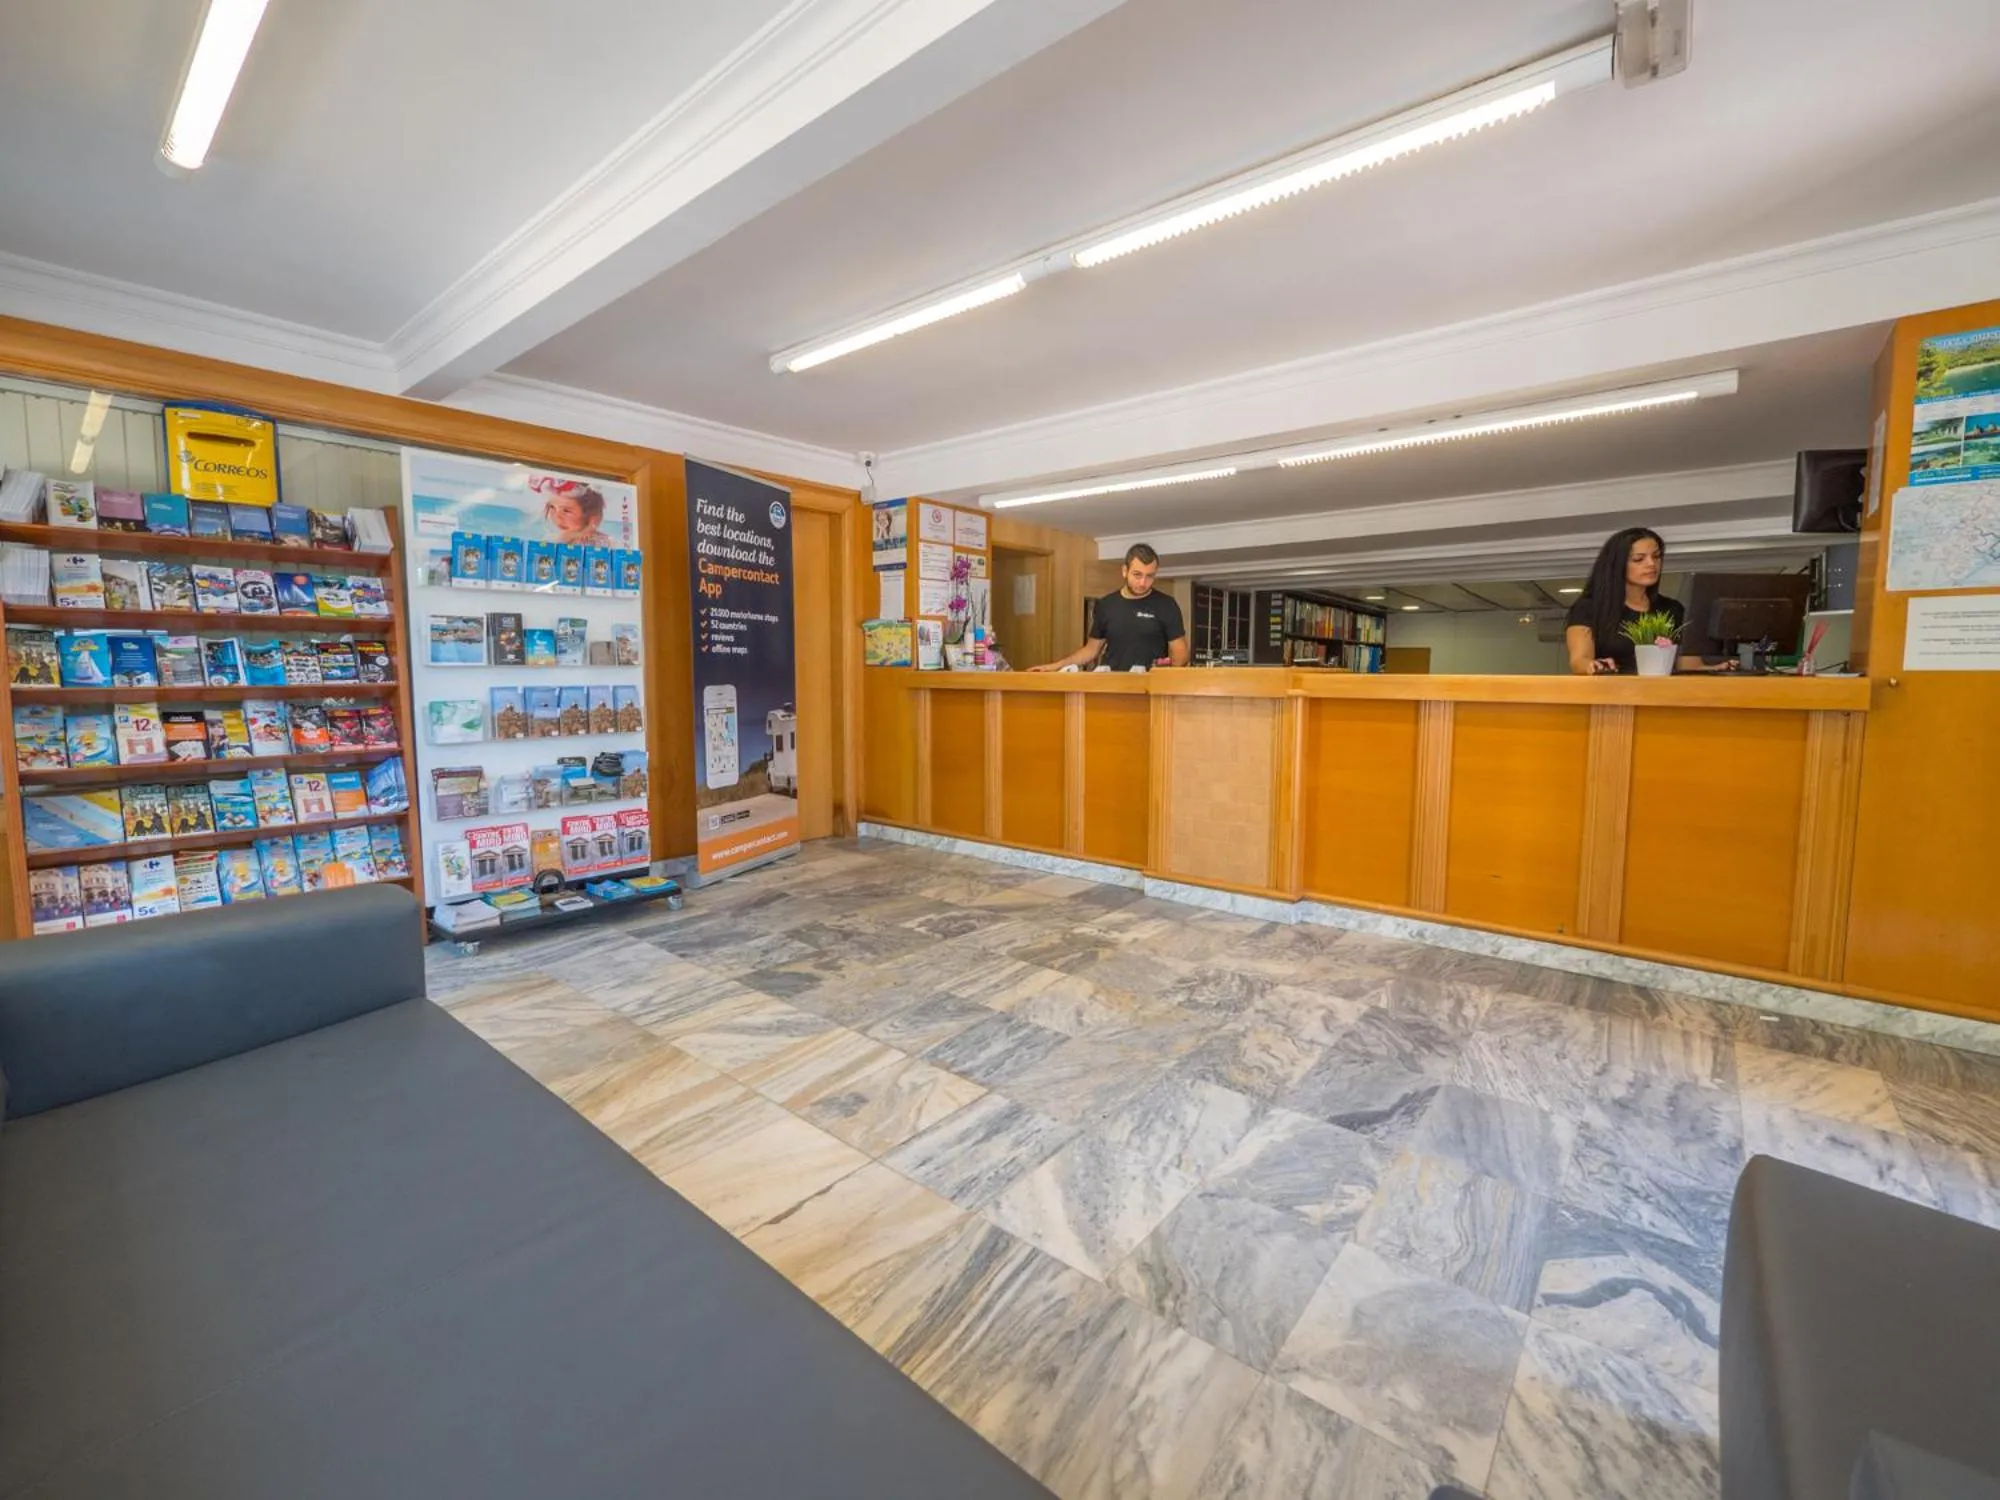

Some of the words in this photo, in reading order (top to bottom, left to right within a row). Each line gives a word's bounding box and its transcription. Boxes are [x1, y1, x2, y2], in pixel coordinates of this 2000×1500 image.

[194, 459, 268, 480] CORREOS
[697, 498, 725, 519] Find
[726, 507, 746, 524] the
[697, 518, 721, 537] best
[723, 524, 775, 551] locations,
[697, 539, 757, 563] download
[758, 551, 776, 566] the
[698, 557, 780, 585] Campercontact
[699, 577, 722, 598] App
[719, 621, 748, 631] countries
[711, 633, 735, 642] reviews
[731, 646, 748, 656] maps
